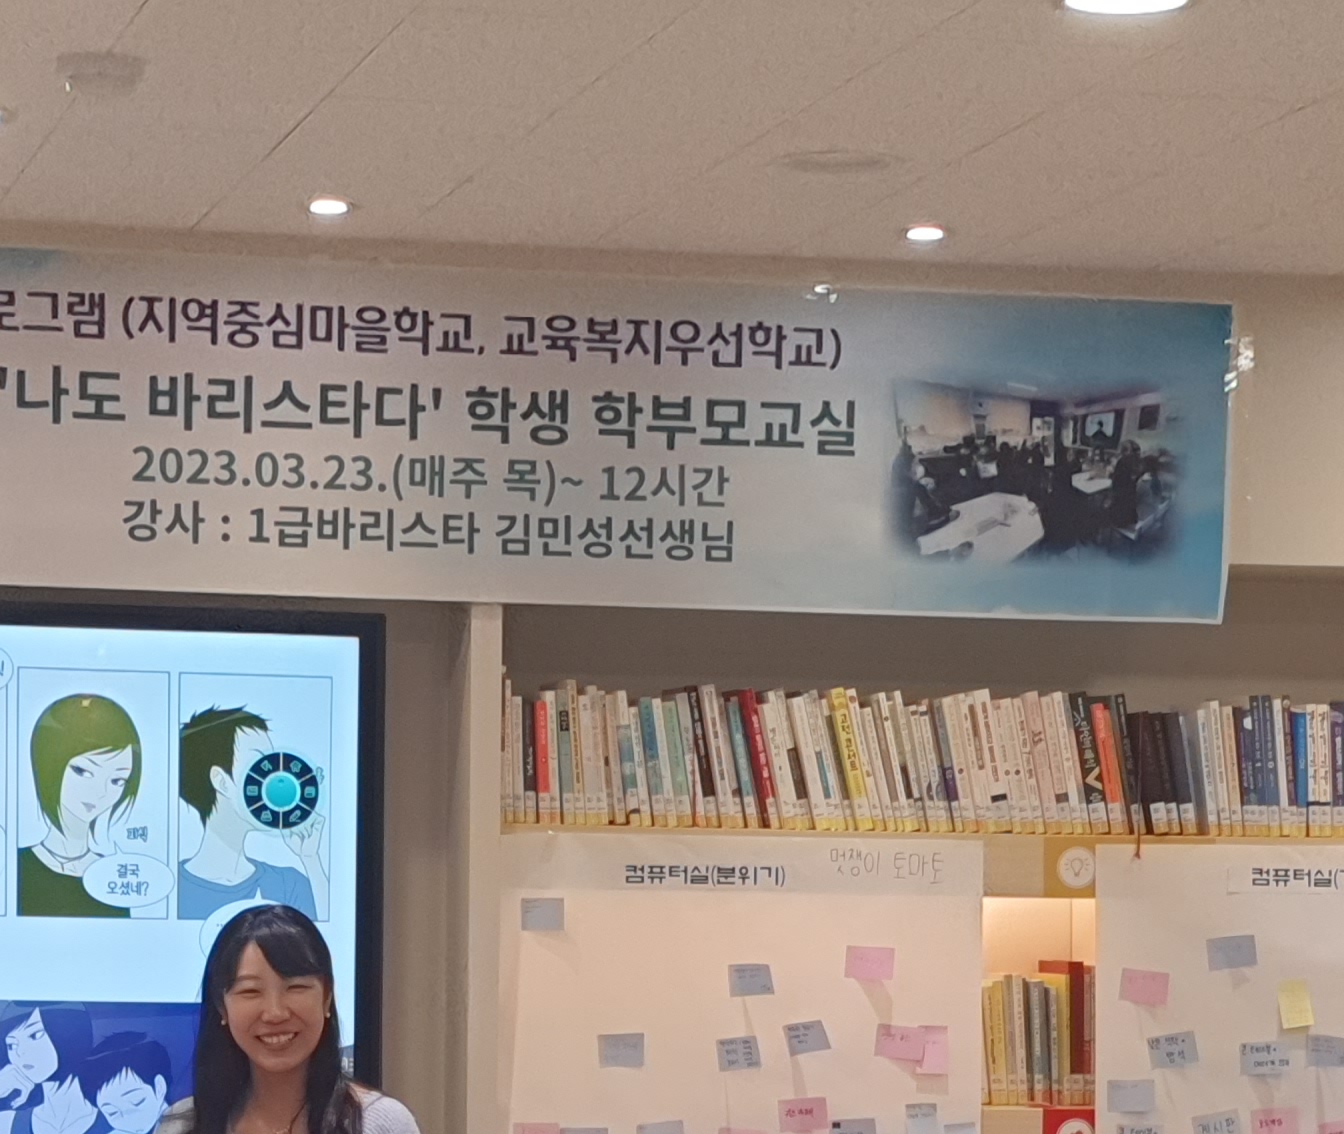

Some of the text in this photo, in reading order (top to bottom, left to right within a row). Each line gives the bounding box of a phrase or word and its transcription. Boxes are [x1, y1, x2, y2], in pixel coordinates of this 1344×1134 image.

[121, 296, 487, 357] (지역중심마을학교,
[499, 314, 842, 371] 교육복지우선학교)
[147, 371, 443, 442] 바리스타다'
[464, 385, 570, 446] 학생
[591, 390, 858, 457] 학부모교실
[131, 444, 730, 508] 2023.03.23.(매주 목)~ 12시간
[122, 499, 205, 546] 강사
[247, 504, 481, 556] 1급바리스타
[494, 512, 735, 563] 김민성선생님
[105, 880, 150, 897] 오셨네?
[116, 863, 141, 879] 결국
[624, 863, 786, 888] 컴퓨터실(분위기)
[829, 847, 946, 885] 멋쟁이 토마토
